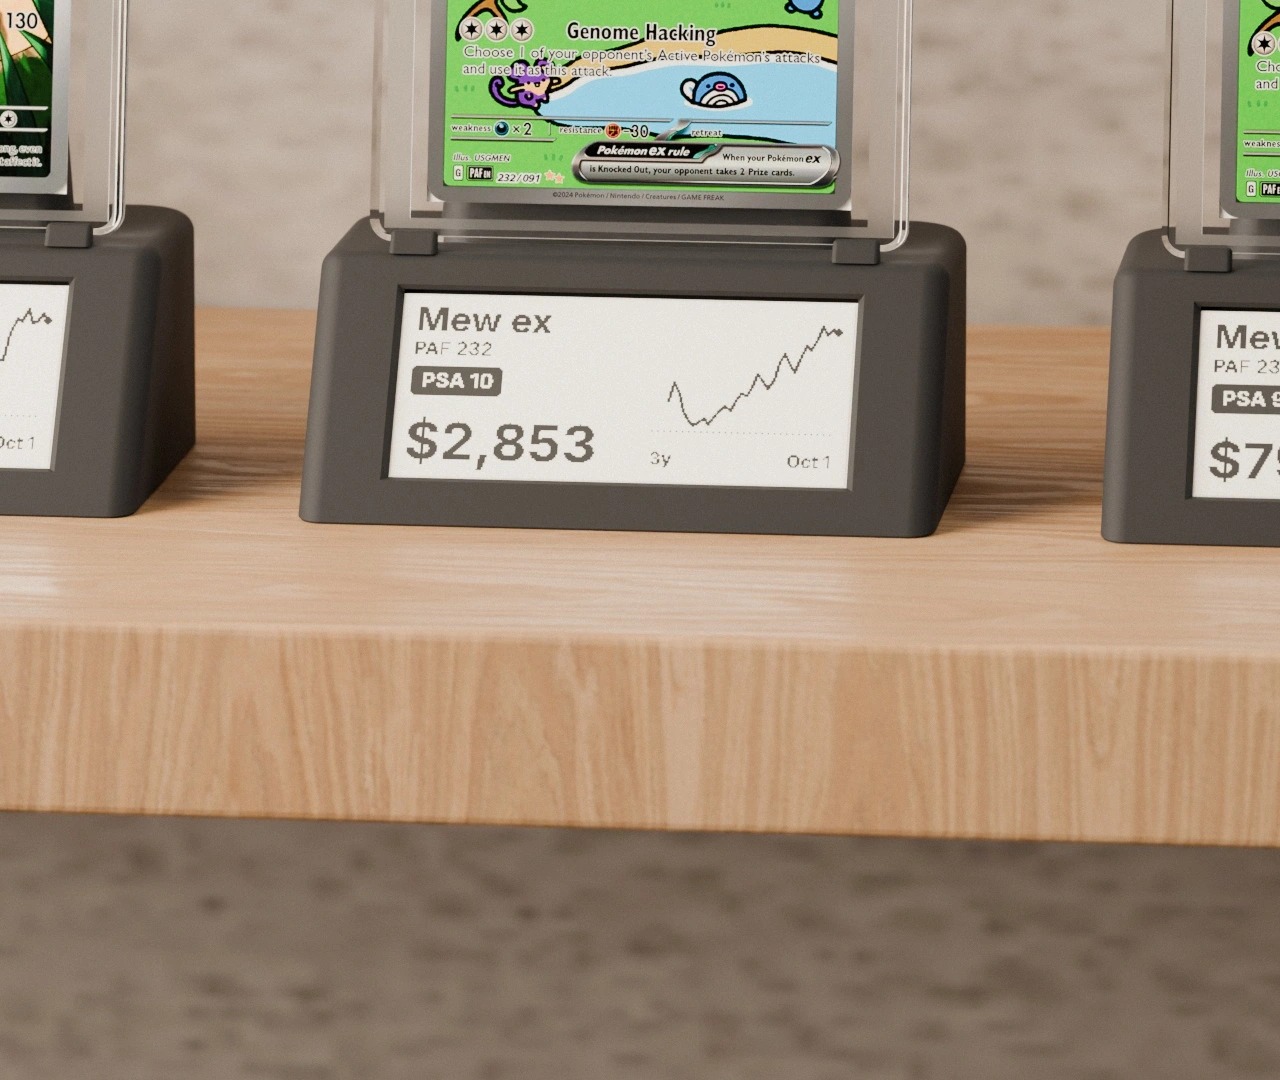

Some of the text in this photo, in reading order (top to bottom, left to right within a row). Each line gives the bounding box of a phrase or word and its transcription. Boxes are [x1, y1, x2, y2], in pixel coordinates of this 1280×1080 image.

[6, 11, 38, 30] 130
[567, 22, 716, 46] Genome Hacking
[451, 123, 492, 132] weakness
[497, 173, 541, 184] 232/091
[418, 306, 552, 334] Mew ex
[414, 341, 493, 357] PAF 232
[1214, 359, 1250, 374] PAF
[422, 373, 494, 390] PSA 10
[1222, 390, 1267, 408] PSA
[28, 436, 35, 450] 1
[406, 416, 595, 471] $2,853
[650, 451, 671, 467] 3y
[787, 455, 830, 469] Oct 1
